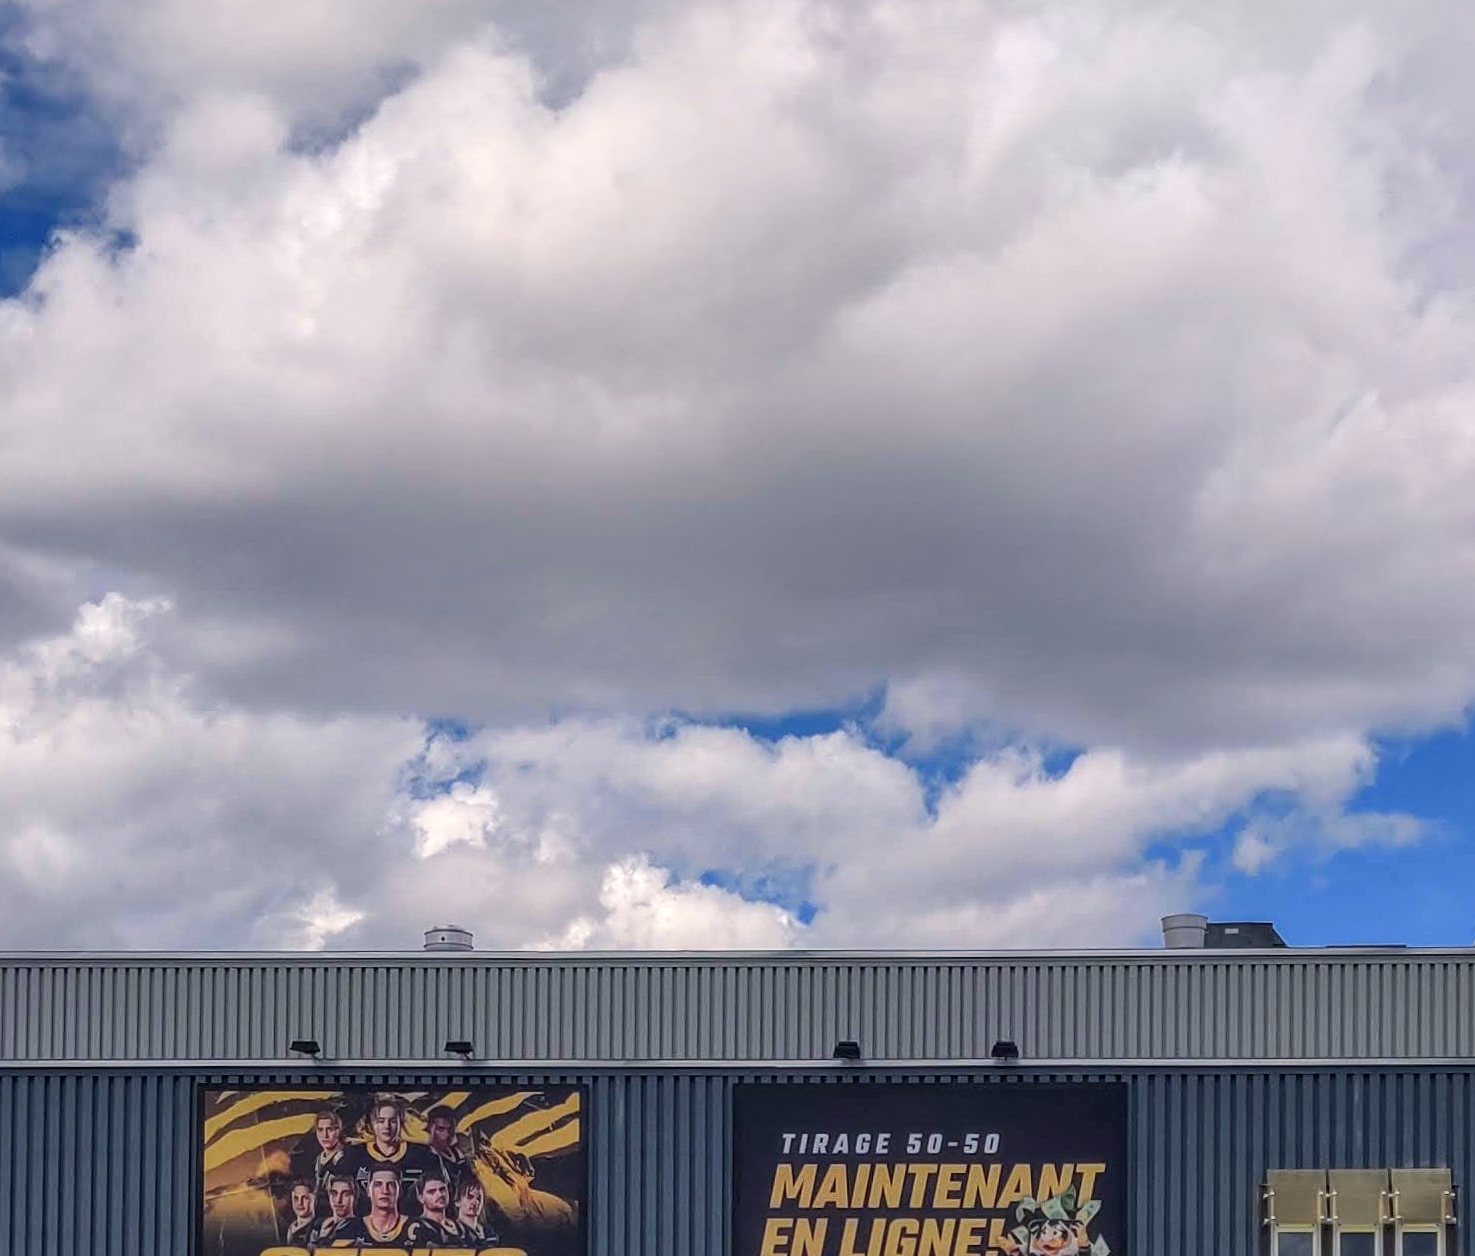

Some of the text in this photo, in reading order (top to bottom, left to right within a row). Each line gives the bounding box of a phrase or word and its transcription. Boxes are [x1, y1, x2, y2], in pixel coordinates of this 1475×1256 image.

[781, 1132, 1002, 1154] TIRAGE 50-50
[769, 1162, 1106, 1209] MAINTENANT
